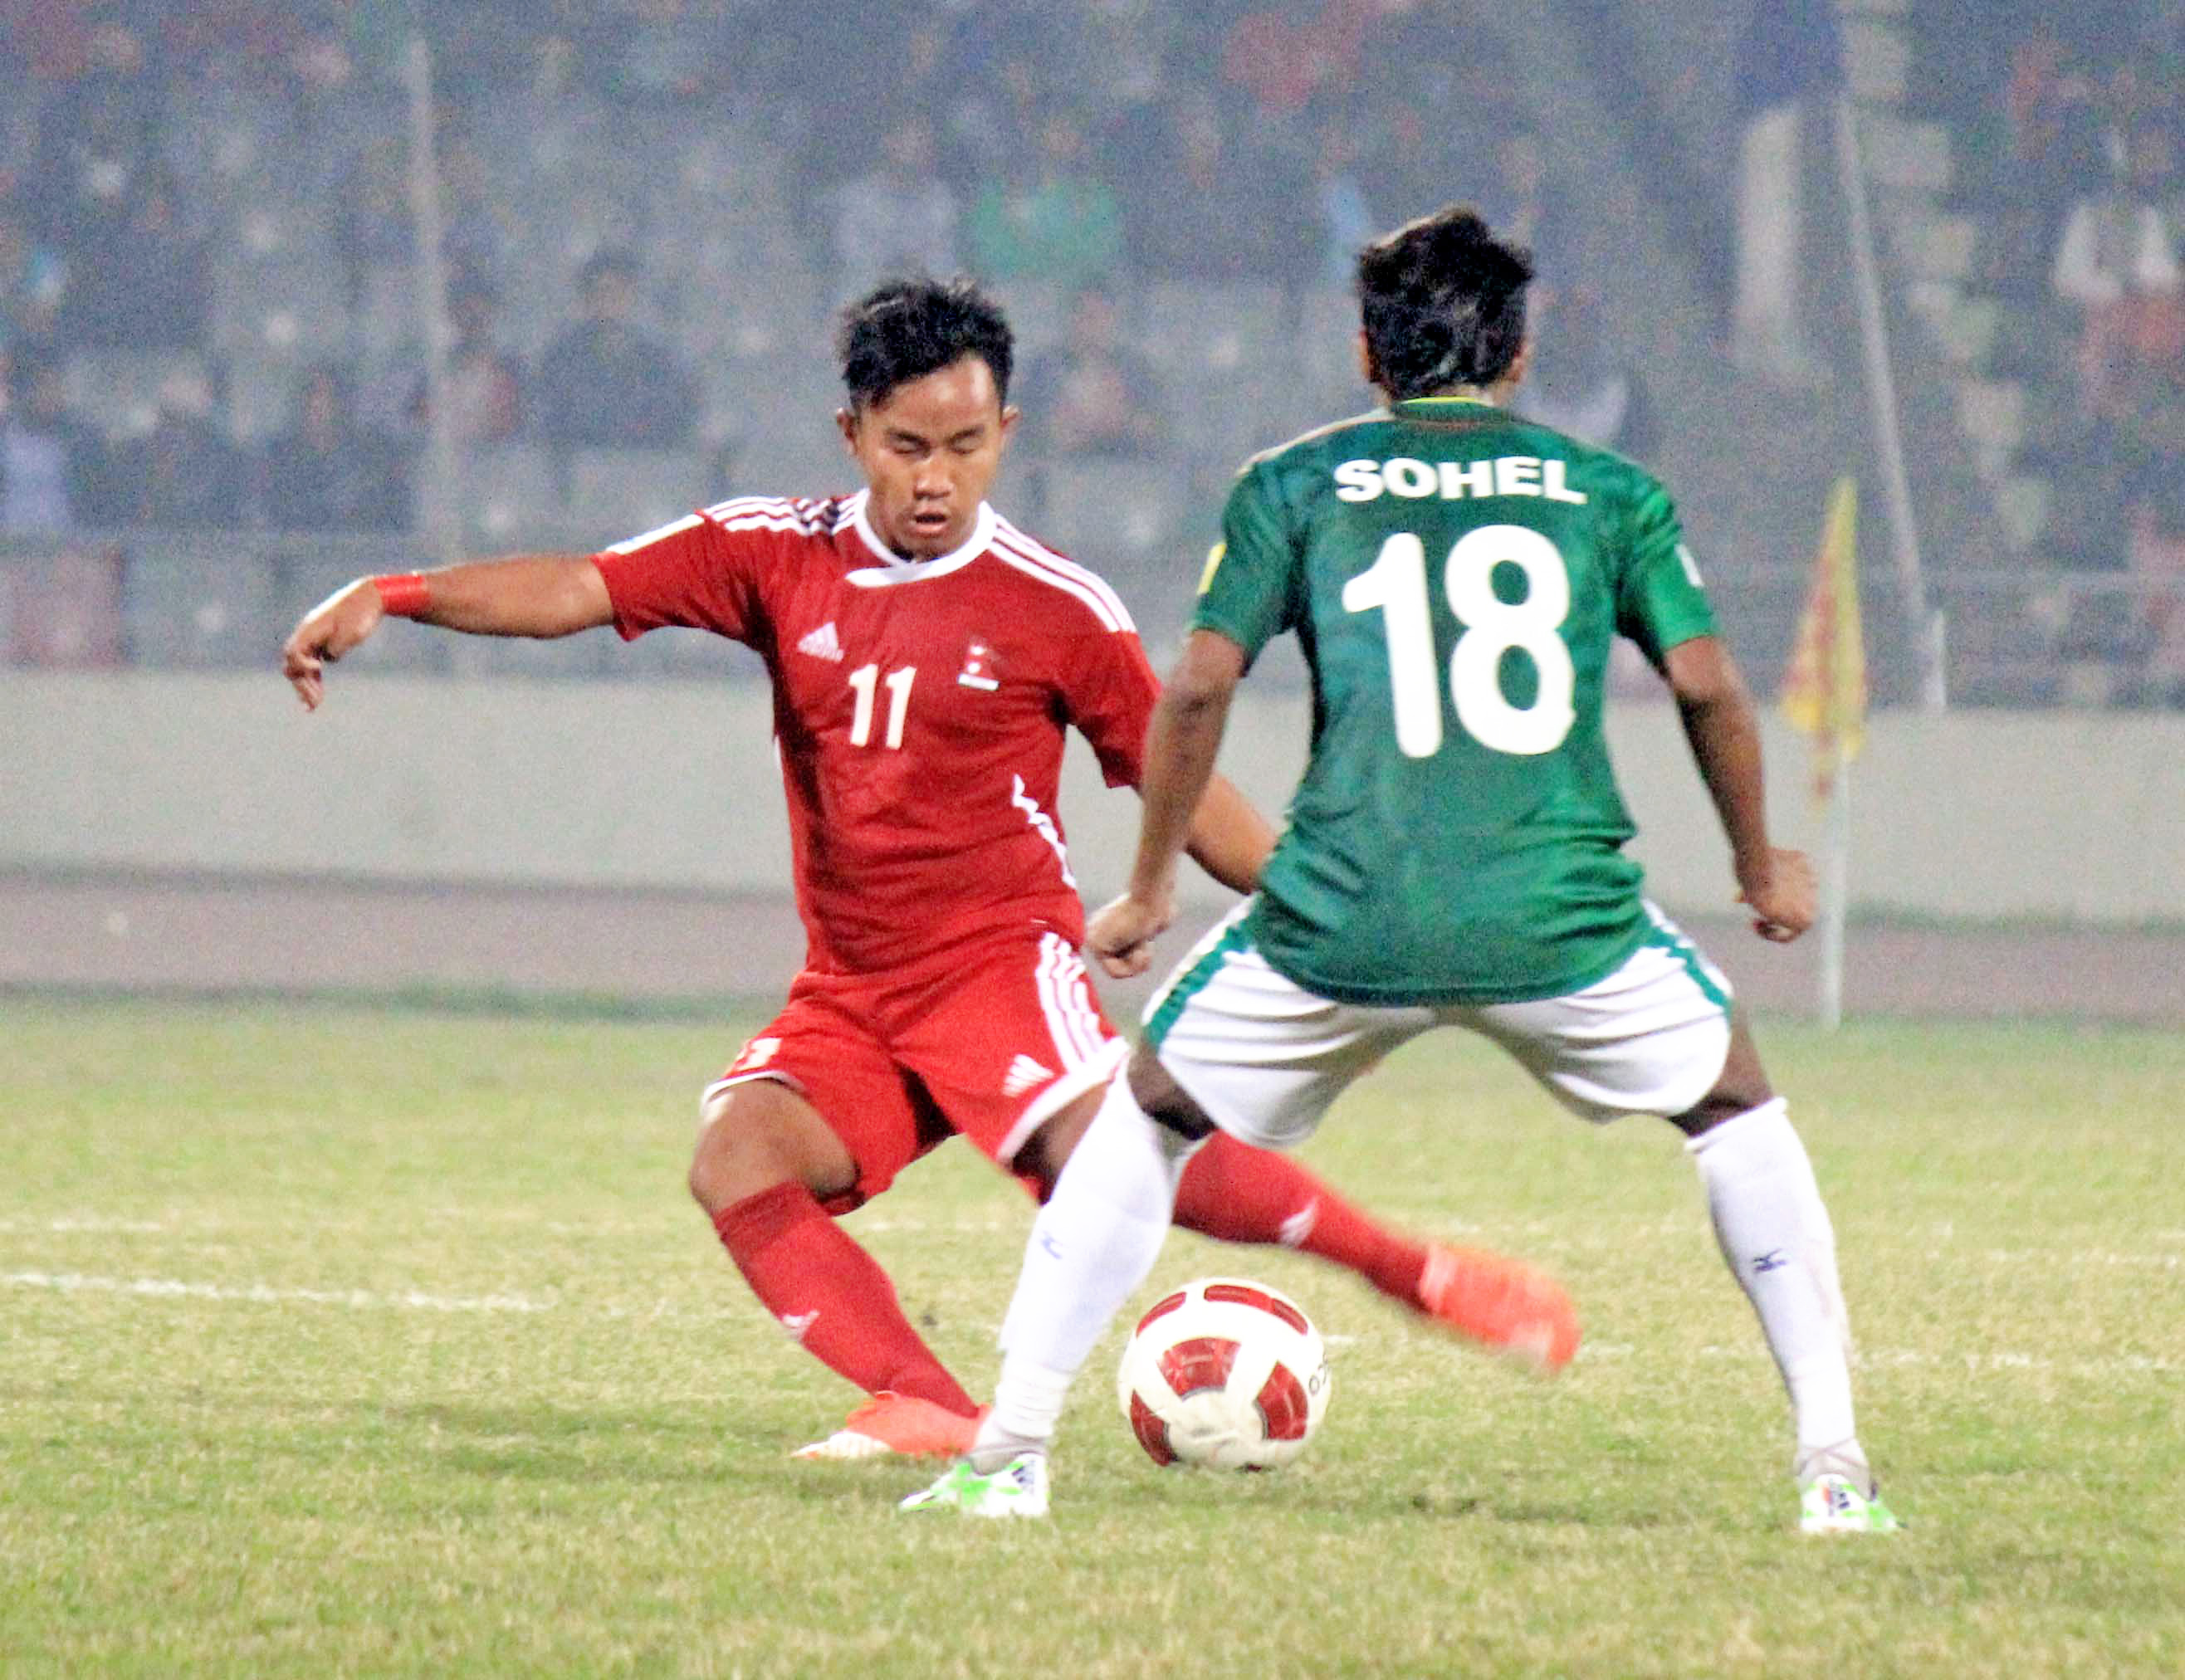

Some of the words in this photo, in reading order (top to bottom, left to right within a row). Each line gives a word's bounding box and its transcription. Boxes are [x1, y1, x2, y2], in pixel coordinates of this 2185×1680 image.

[1333, 456, 1587, 505] SOHEL
[1342, 524, 1577, 759] 18
[848, 663, 917, 750] 11
